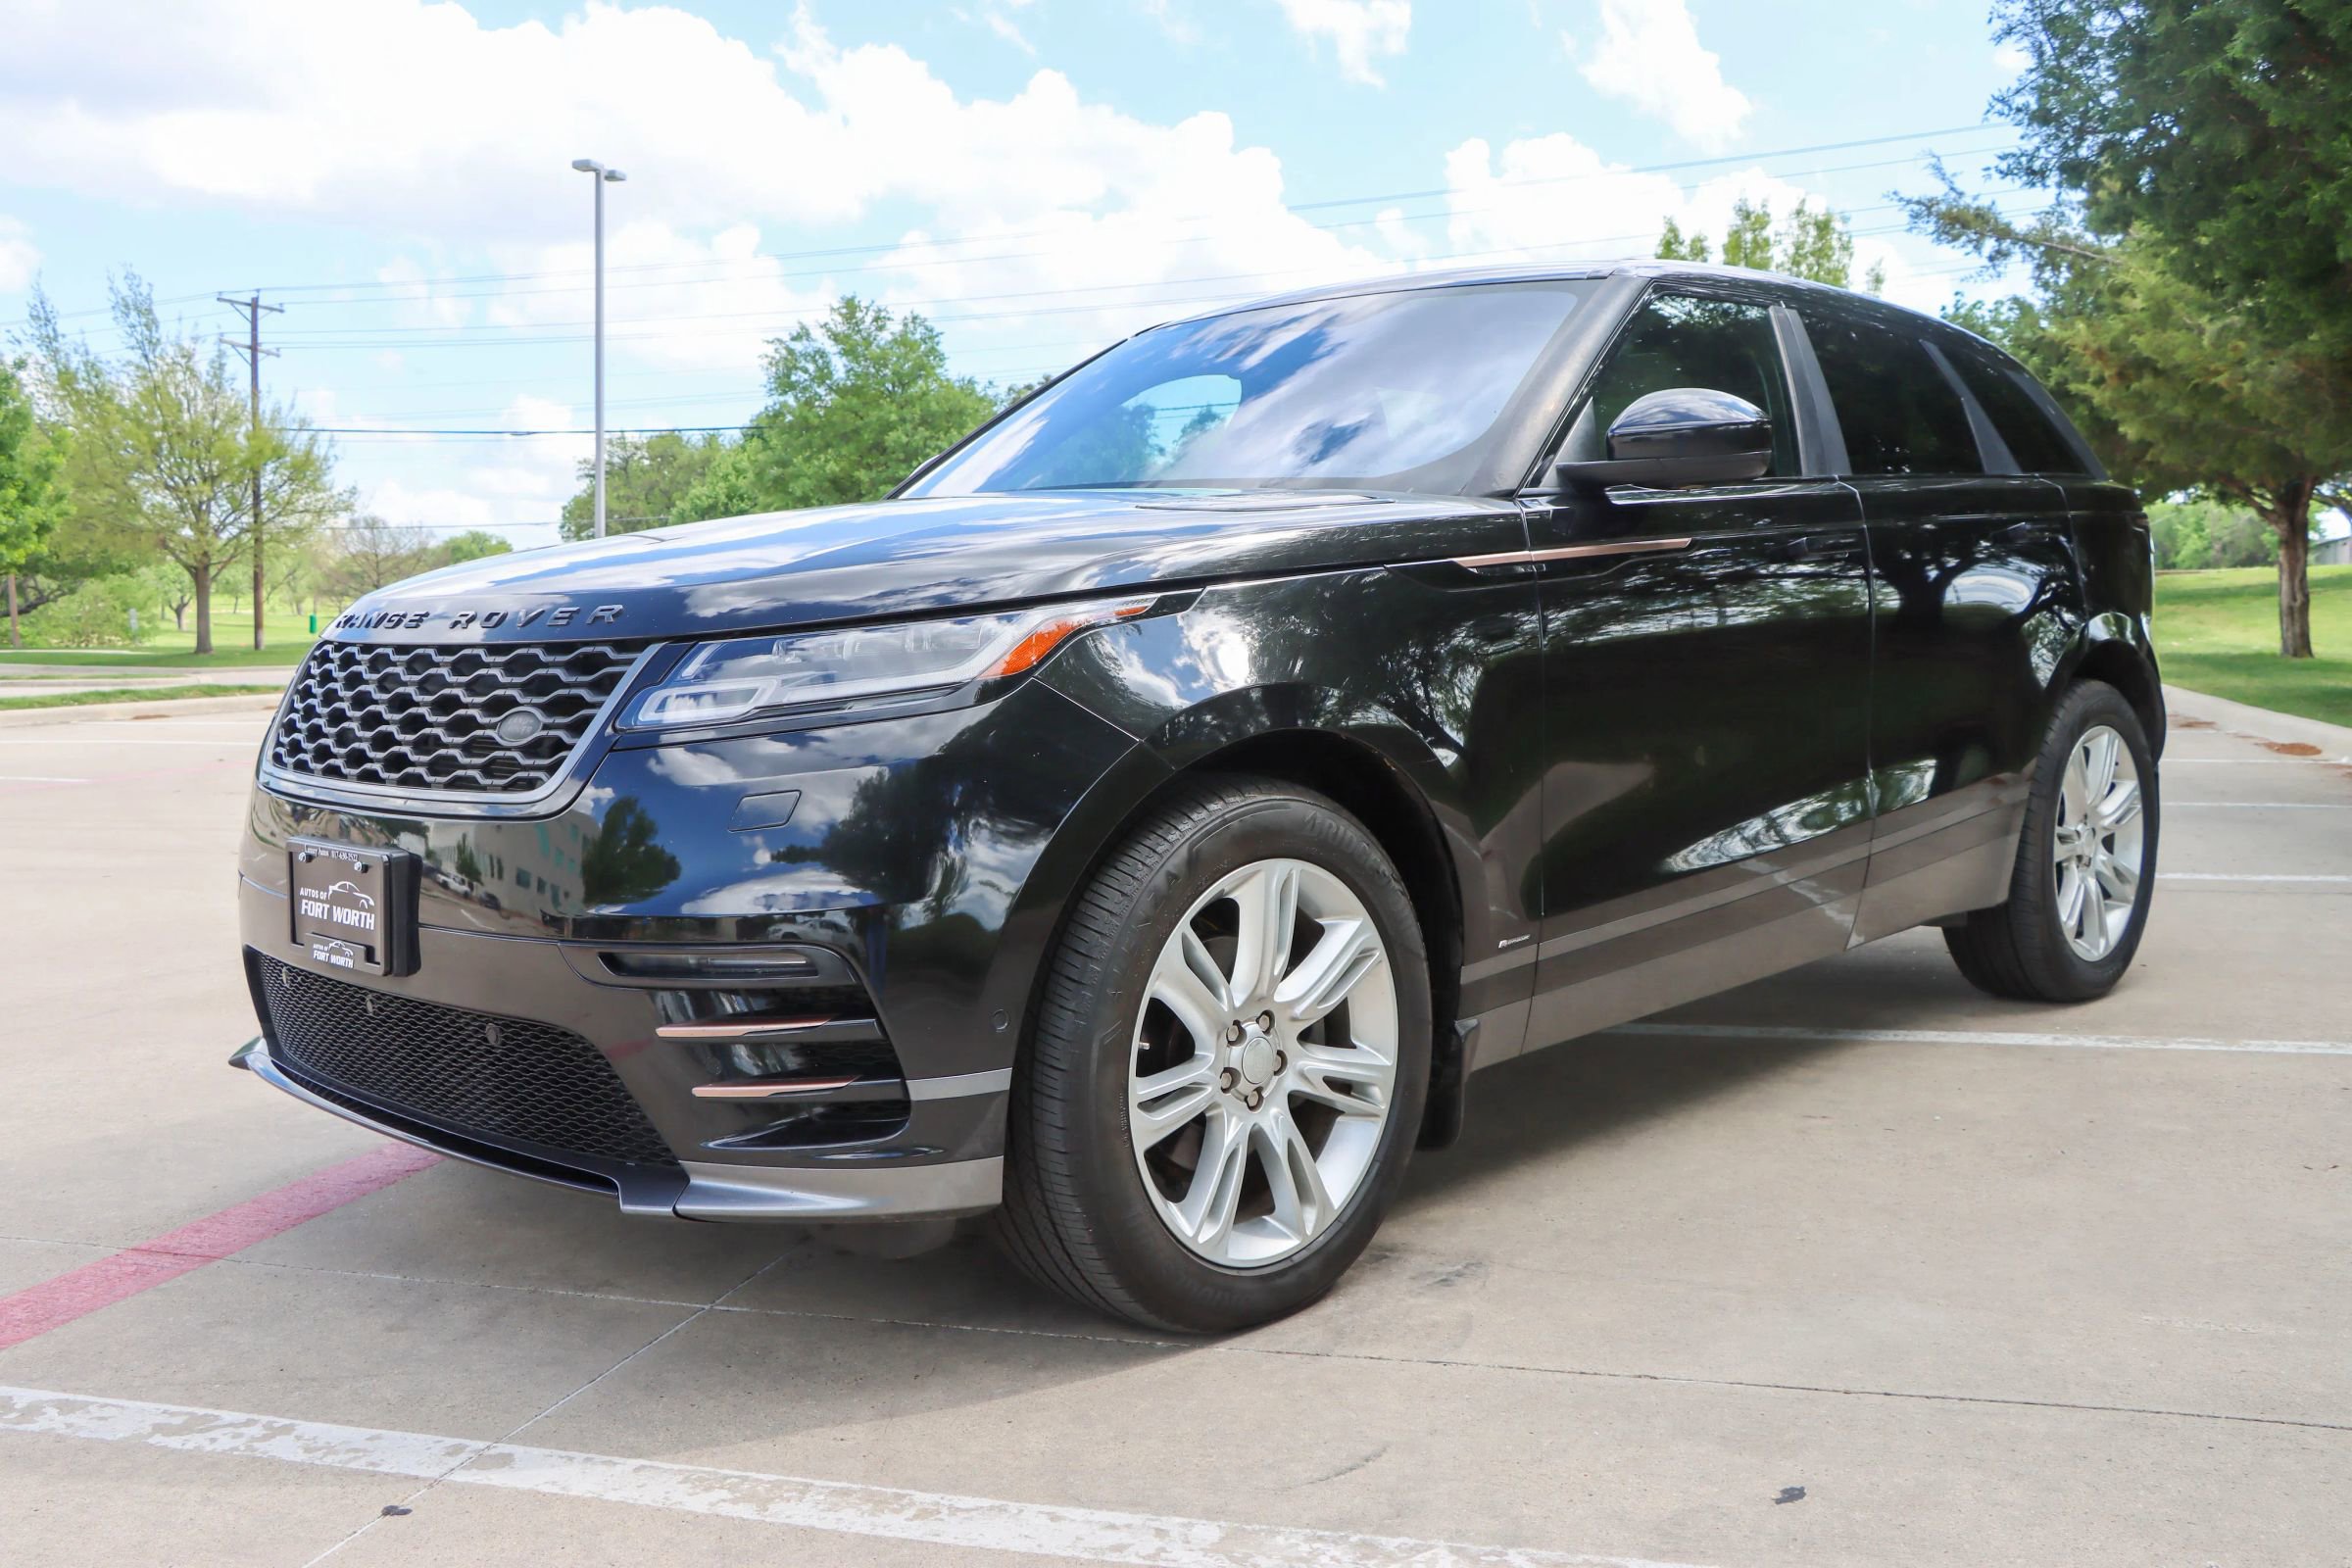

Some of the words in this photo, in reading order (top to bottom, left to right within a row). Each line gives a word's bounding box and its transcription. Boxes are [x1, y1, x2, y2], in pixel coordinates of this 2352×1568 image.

[335, 611, 430, 629] RANGE
[449, 604, 624, 630] ROVER
[300, 887, 318, 898] AUTOS
[319, 891, 327, 901] OF
[301, 900, 330, 919] FORT
[332, 906, 375, 931] WORTH
[313, 950, 329, 962] FORT
[330, 954, 354, 969] WORTH
